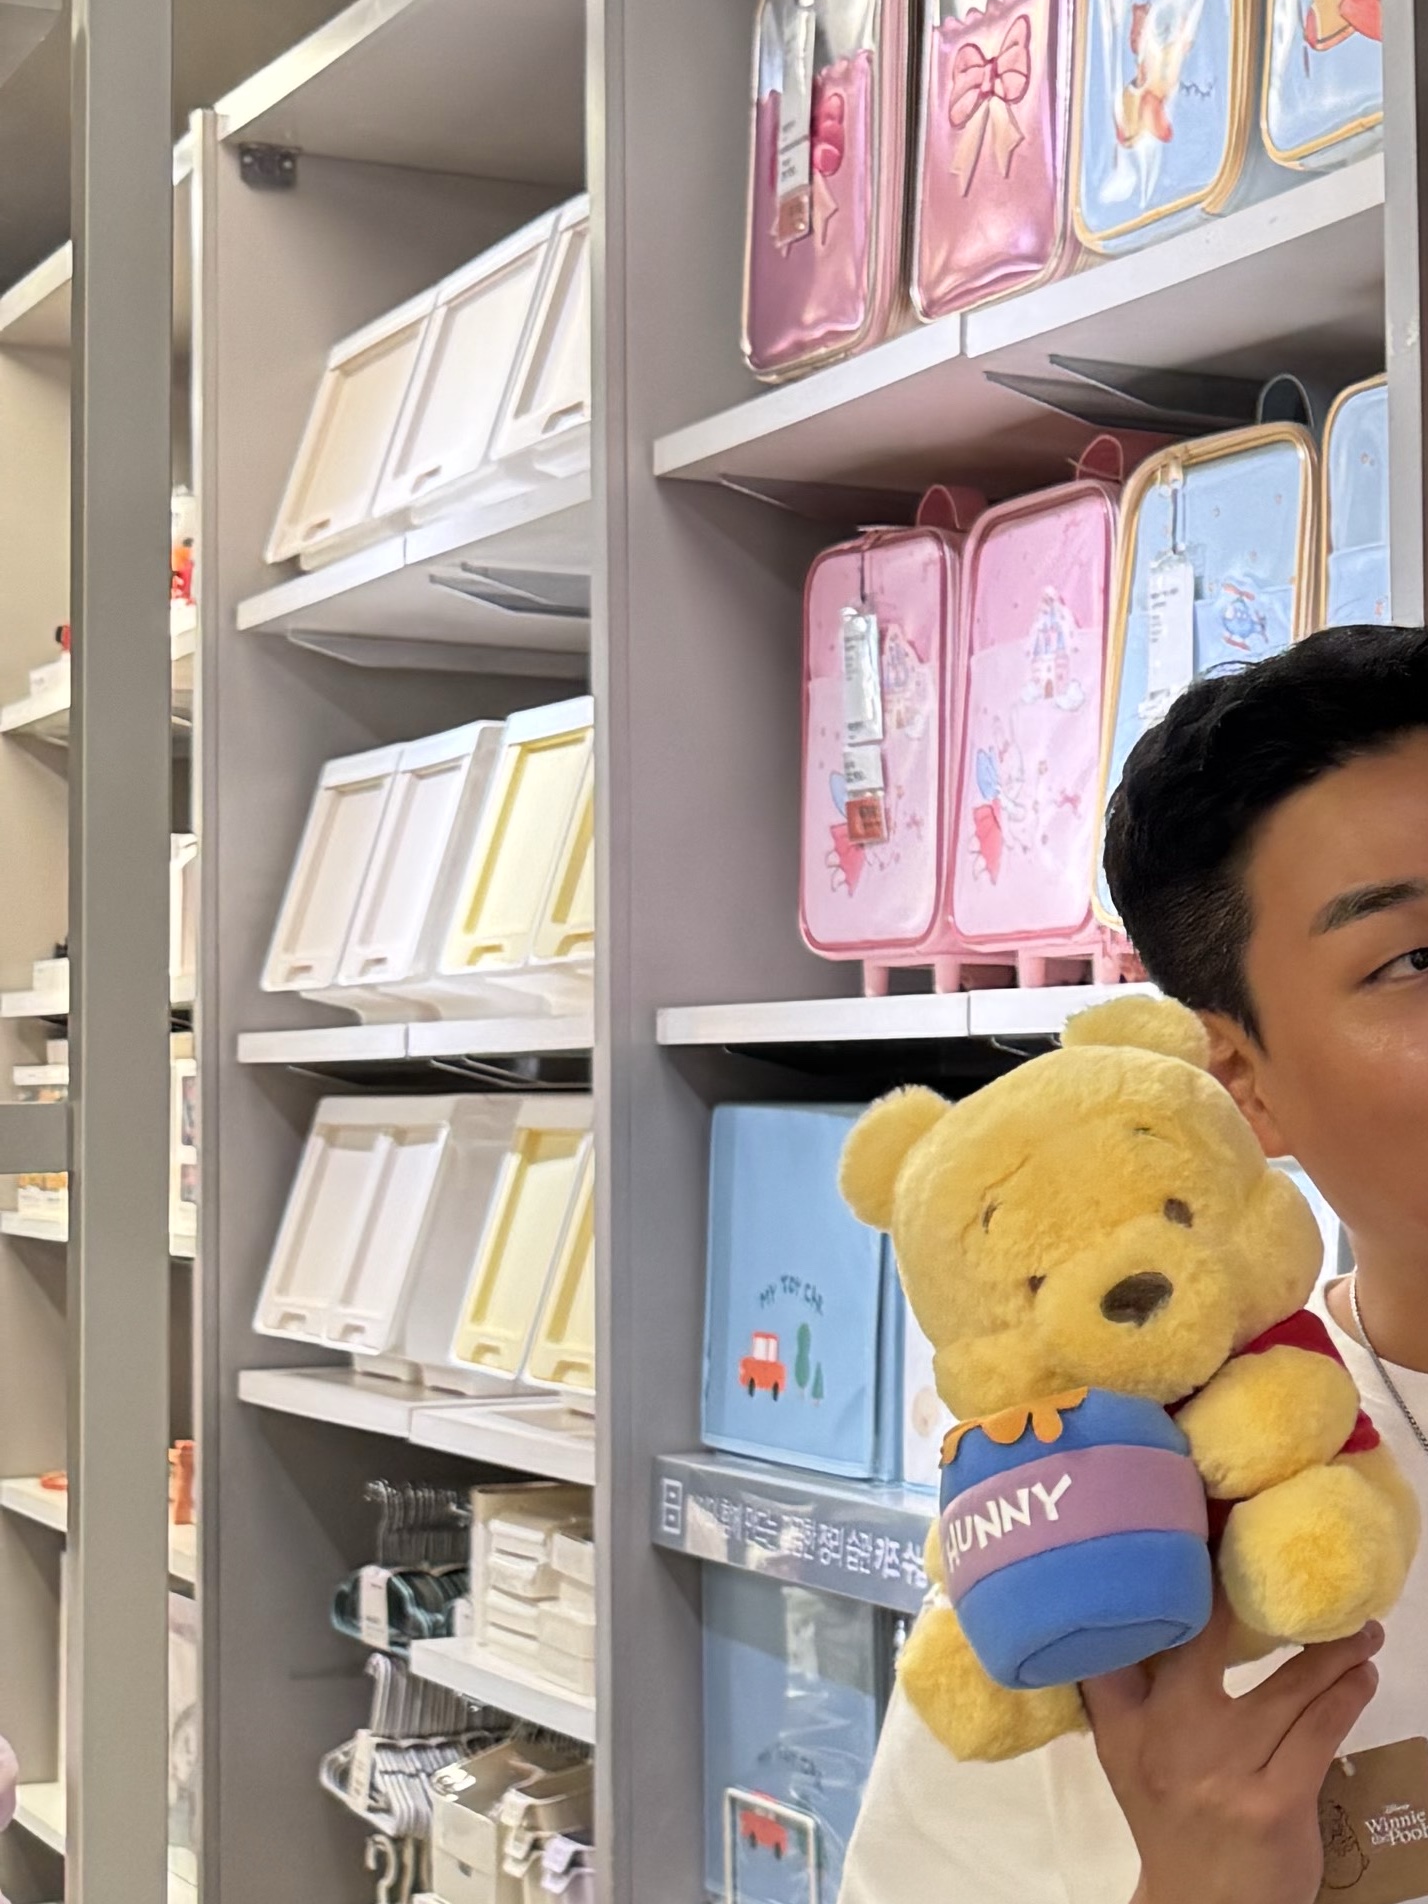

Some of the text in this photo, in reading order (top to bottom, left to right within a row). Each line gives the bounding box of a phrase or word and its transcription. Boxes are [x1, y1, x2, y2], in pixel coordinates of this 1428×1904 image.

[818, 1522, 845, 1567] 정리
[845, 1530, 873, 1575] 습관
[873, 1536, 901, 1579] 키즈
[946, 1473, 1073, 1574] HUNNY
[1364, 1810, 1427, 1833] Winnie
